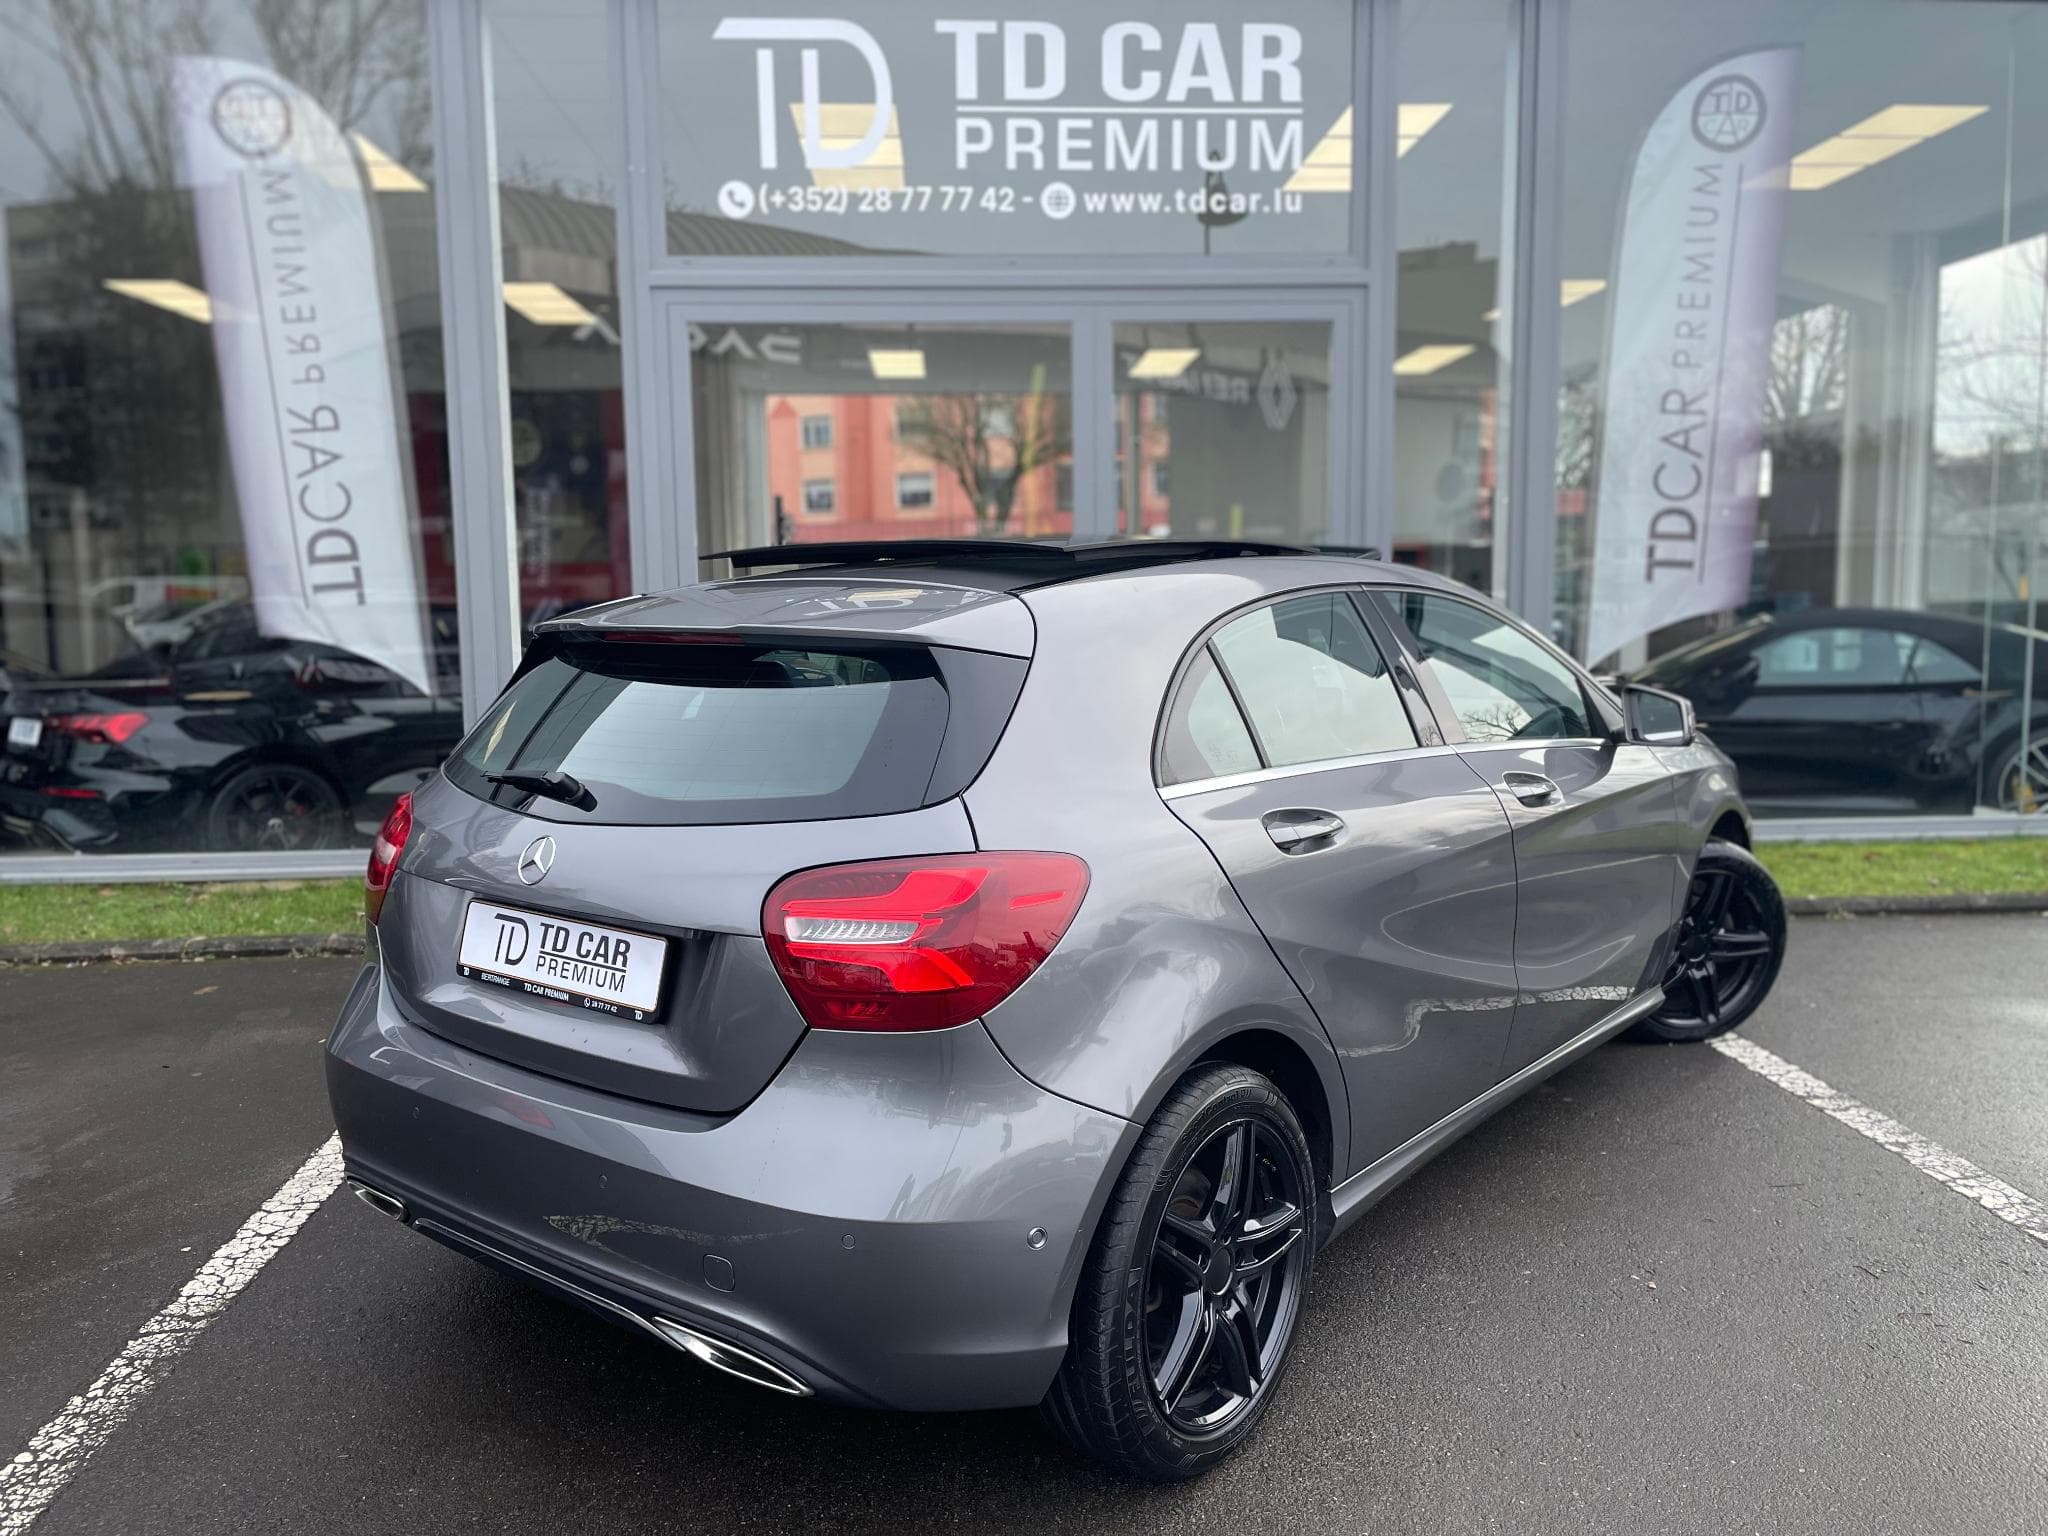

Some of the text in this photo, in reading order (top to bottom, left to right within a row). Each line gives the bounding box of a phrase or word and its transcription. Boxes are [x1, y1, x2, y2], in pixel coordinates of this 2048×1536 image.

[934, 19, 1302, 103] TD CAR
[956, 117, 1303, 170] PREMIUM
[759, 183, 849, 215] (+352)
[858, 187, 893, 213] 28
[901, 186, 932, 212] 77
[939, 187, 974, 212] 77
[979, 187, 1015, 213] 42
[1083, 187, 1303, 213] www.tdcar.lu
[1672, 163, 1722, 370] PREMIUM
[540, 922, 631, 968] TD CAR
[523, 982, 569, 1002] TD CAR PREMIUM
[535, 955, 626, 993] PREMIUM
